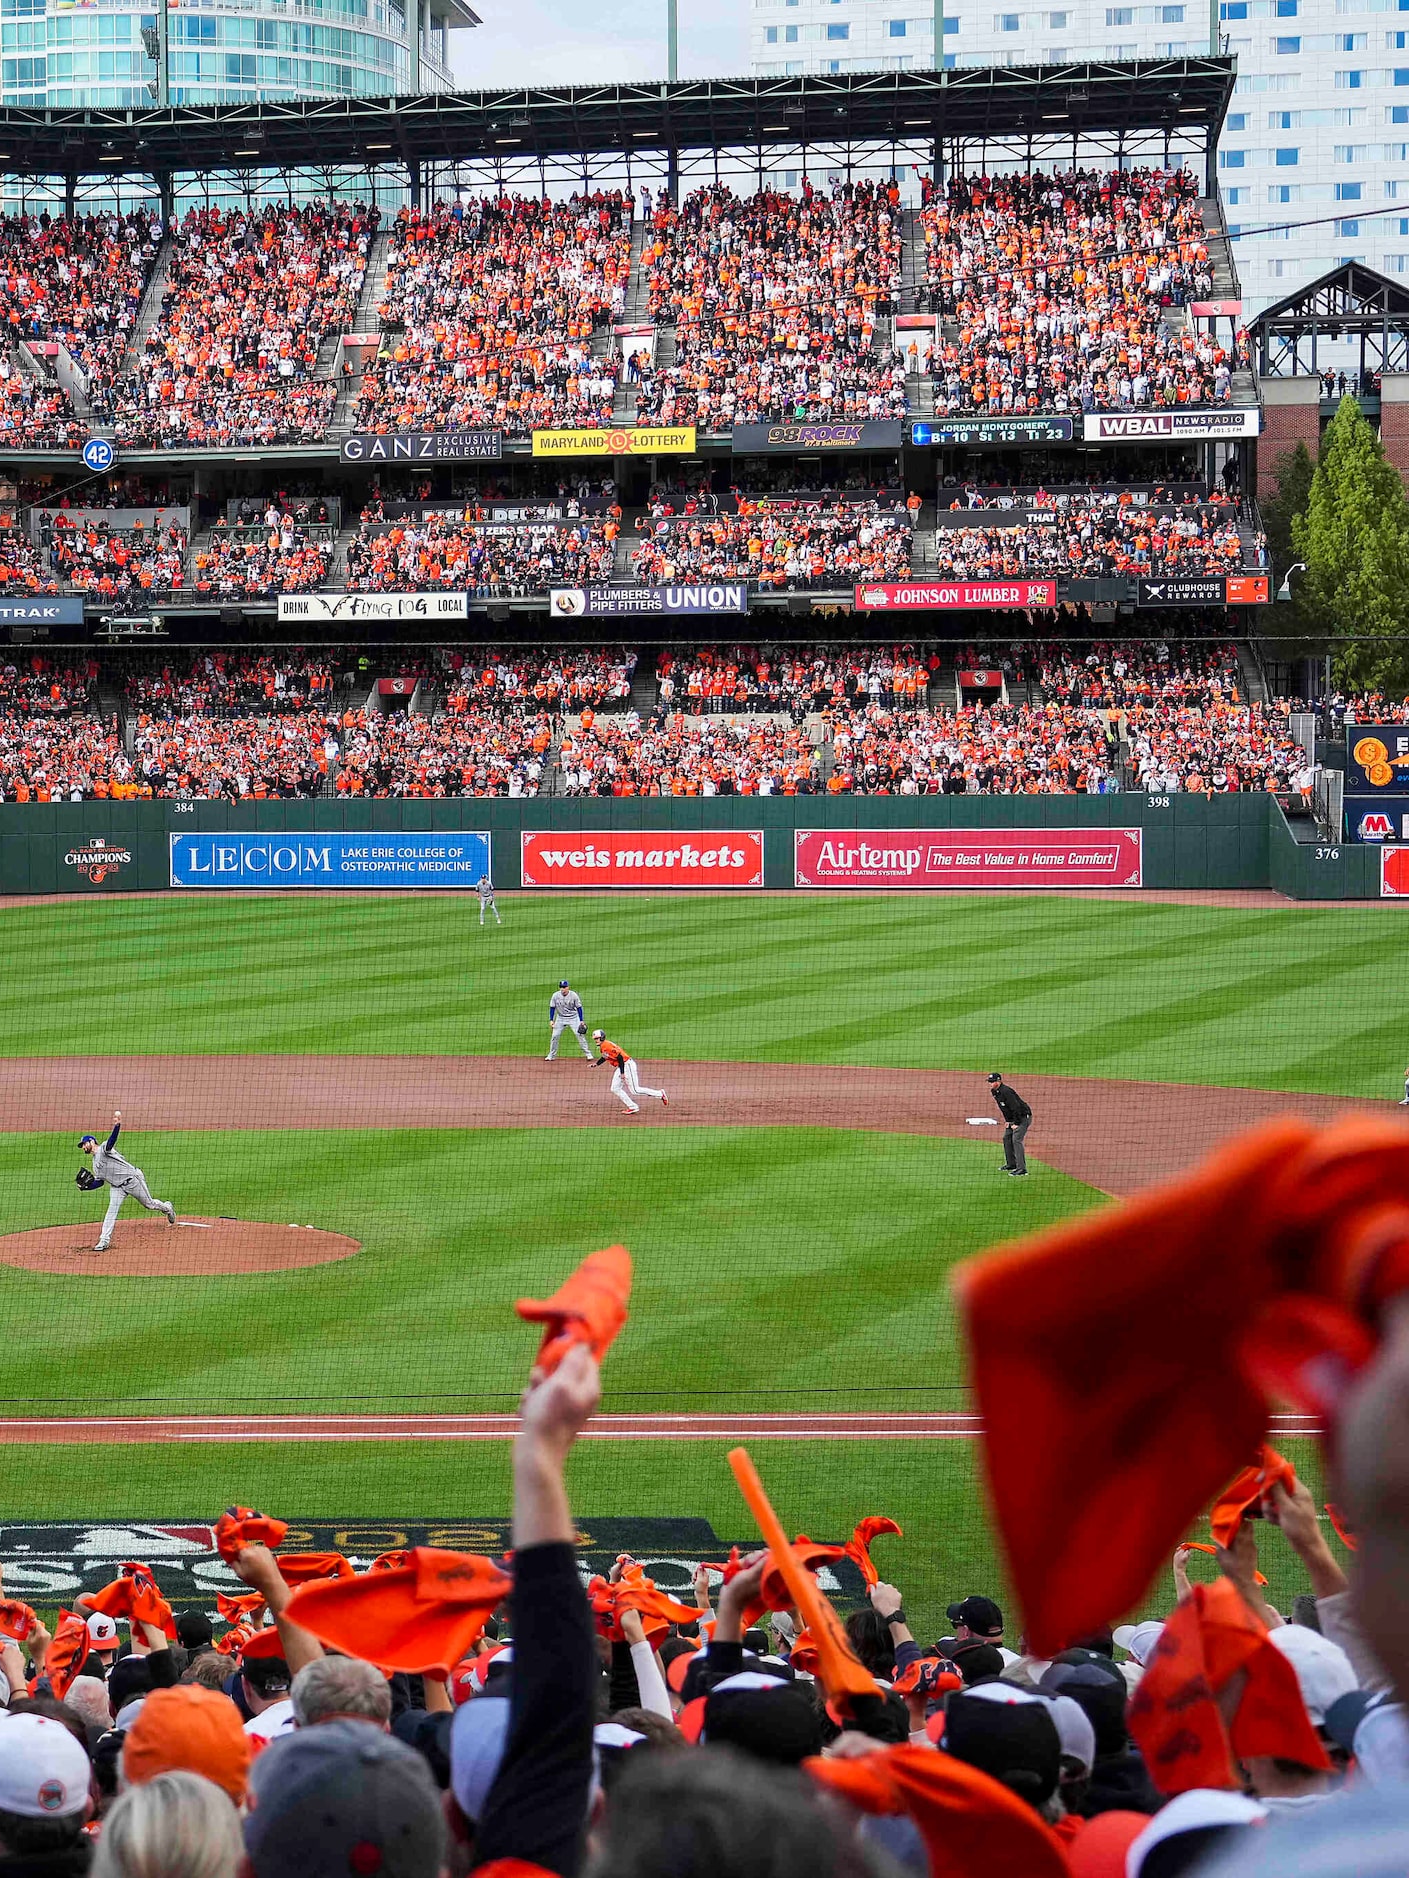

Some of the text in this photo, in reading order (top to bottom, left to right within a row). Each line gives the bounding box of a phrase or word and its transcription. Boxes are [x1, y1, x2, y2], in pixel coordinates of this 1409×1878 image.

[940, 421, 1051, 434] JORDAN MONTGOMERY
[1102, 418, 1171, 435] WBAL
[1175, 416, 1243, 426] NEWSRADIO
[437, 435, 497, 446] EXCLUSIVE
[540, 437, 604, 449] MARYLAND
[633, 434, 687, 447] LOTTERY
[821, 438, 856, 447] baltimore
[931, 429, 1064, 443] B: 10 S: 13 T: 23
[87, 445, 110, 464] 42
[344, 437, 434, 460] GANZ
[437, 446, 497, 457] REAL ESTATE
[1025, 513, 1056, 523] THAT
[1168, 583, 1220, 592] CLUBHOUSE
[590, 589, 661, 600] PLUMBERS &
[666, 586, 742, 608] UNION
[893, 588, 958, 604] JOHNSON
[965, 587, 1020, 602] LUMBER
[1168, 592, 1220, 600] REWARDS
[283, 601, 309, 614] DRINK
[350, 597, 429, 617] FLYING DOG
[438, 599, 464, 612] LOCAL
[590, 600, 663, 612] PIPE FITTERS
[174, 803, 194, 813] 384
[1147, 796, 1170, 808] 398
[64, 852, 132, 865] CHAMPIONS
[188, 846, 332, 872] LECOM
[341, 848, 463, 858] LAKE ERIE COLLEGE OF
[540, 845, 746, 868] weis markets
[816, 841, 921, 875] Airtemp
[933, 852, 1114, 866] The Best Value in Home Comfort
[1315, 848, 1339, 860] 376
[341, 861, 472, 872] OSTEOPATHIC MEDICINE
